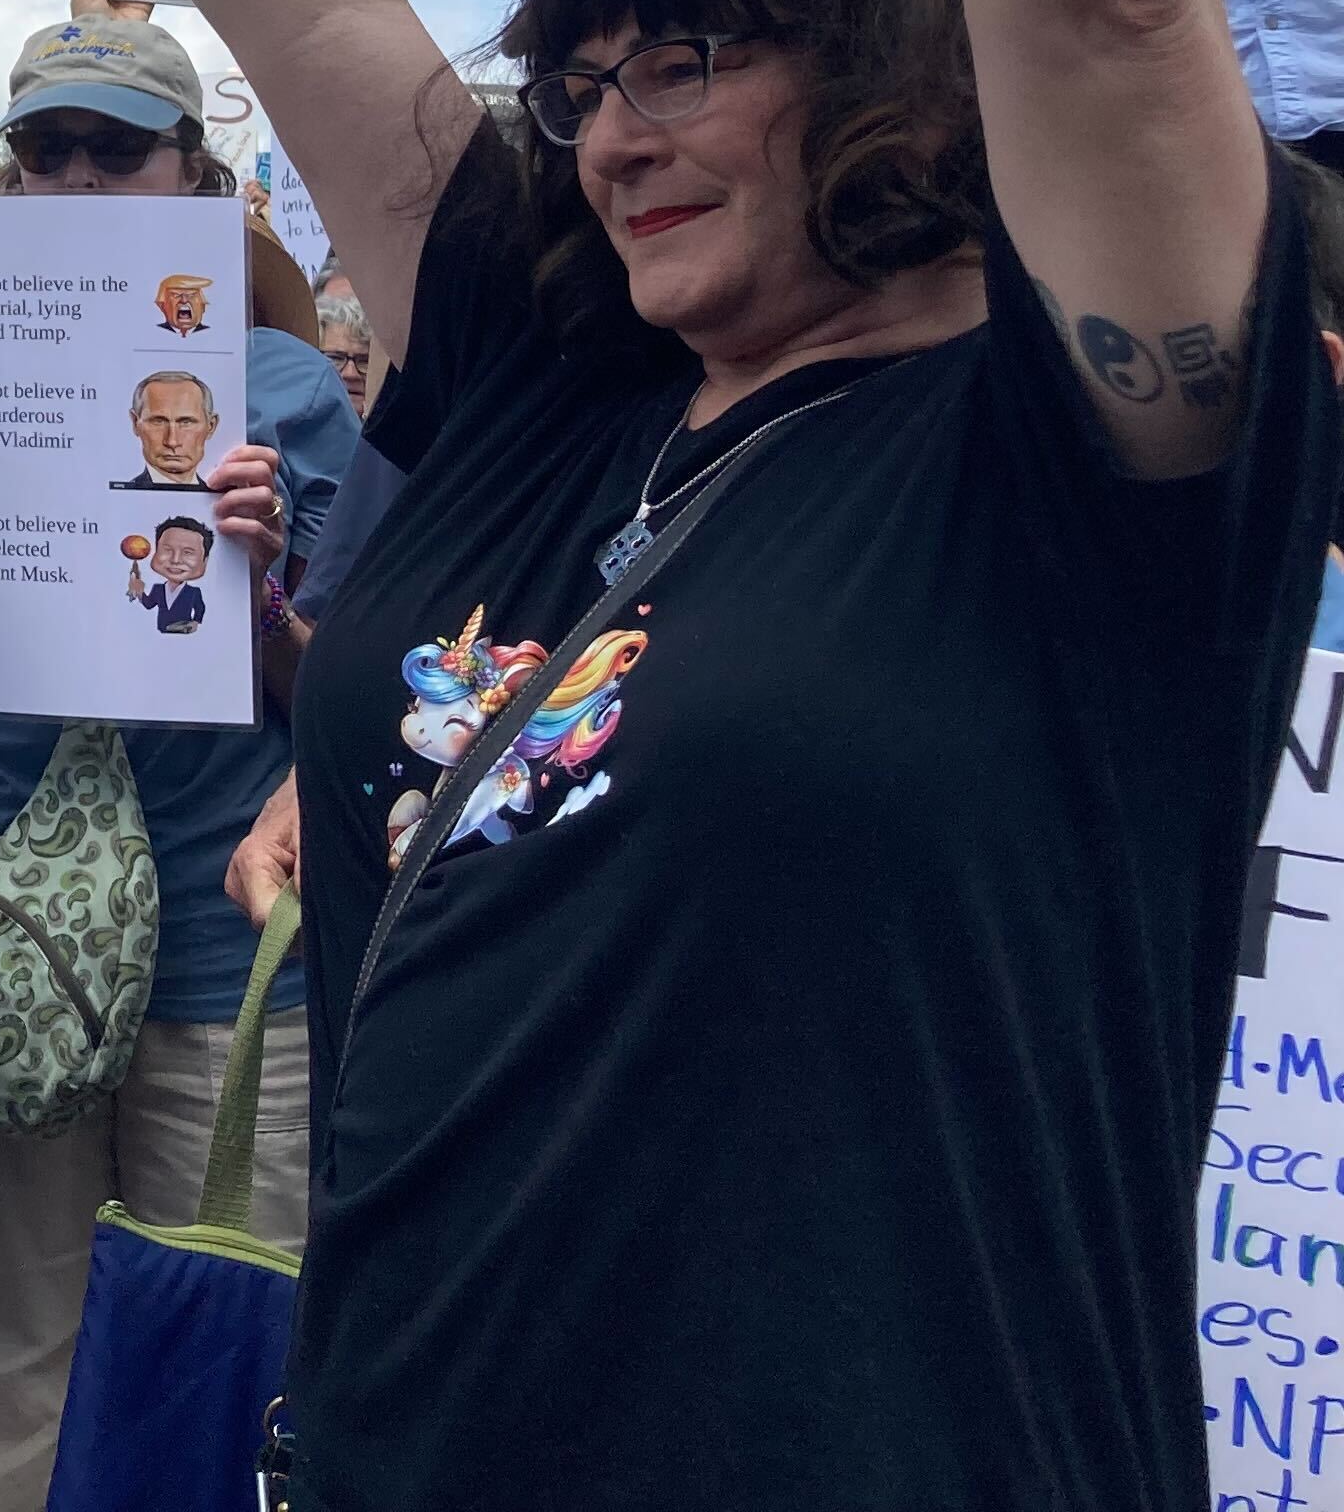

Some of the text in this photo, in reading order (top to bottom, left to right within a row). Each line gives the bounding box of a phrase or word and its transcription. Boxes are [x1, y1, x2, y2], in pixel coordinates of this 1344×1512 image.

[12, 276, 74, 293] believe
[79, 276, 96, 292] in
[101, 276, 128, 293] the
[37, 300, 82, 321] lying
[9, 325, 71, 345] Trump.
[13, 383, 75, 401] believe
[80, 383, 97, 401] in
[0, 432, 75, 450] Vladimir
[15, 516, 76, 535] believe
[81, 517, 99, 535] in
[21, 566, 74, 585] Musk.
